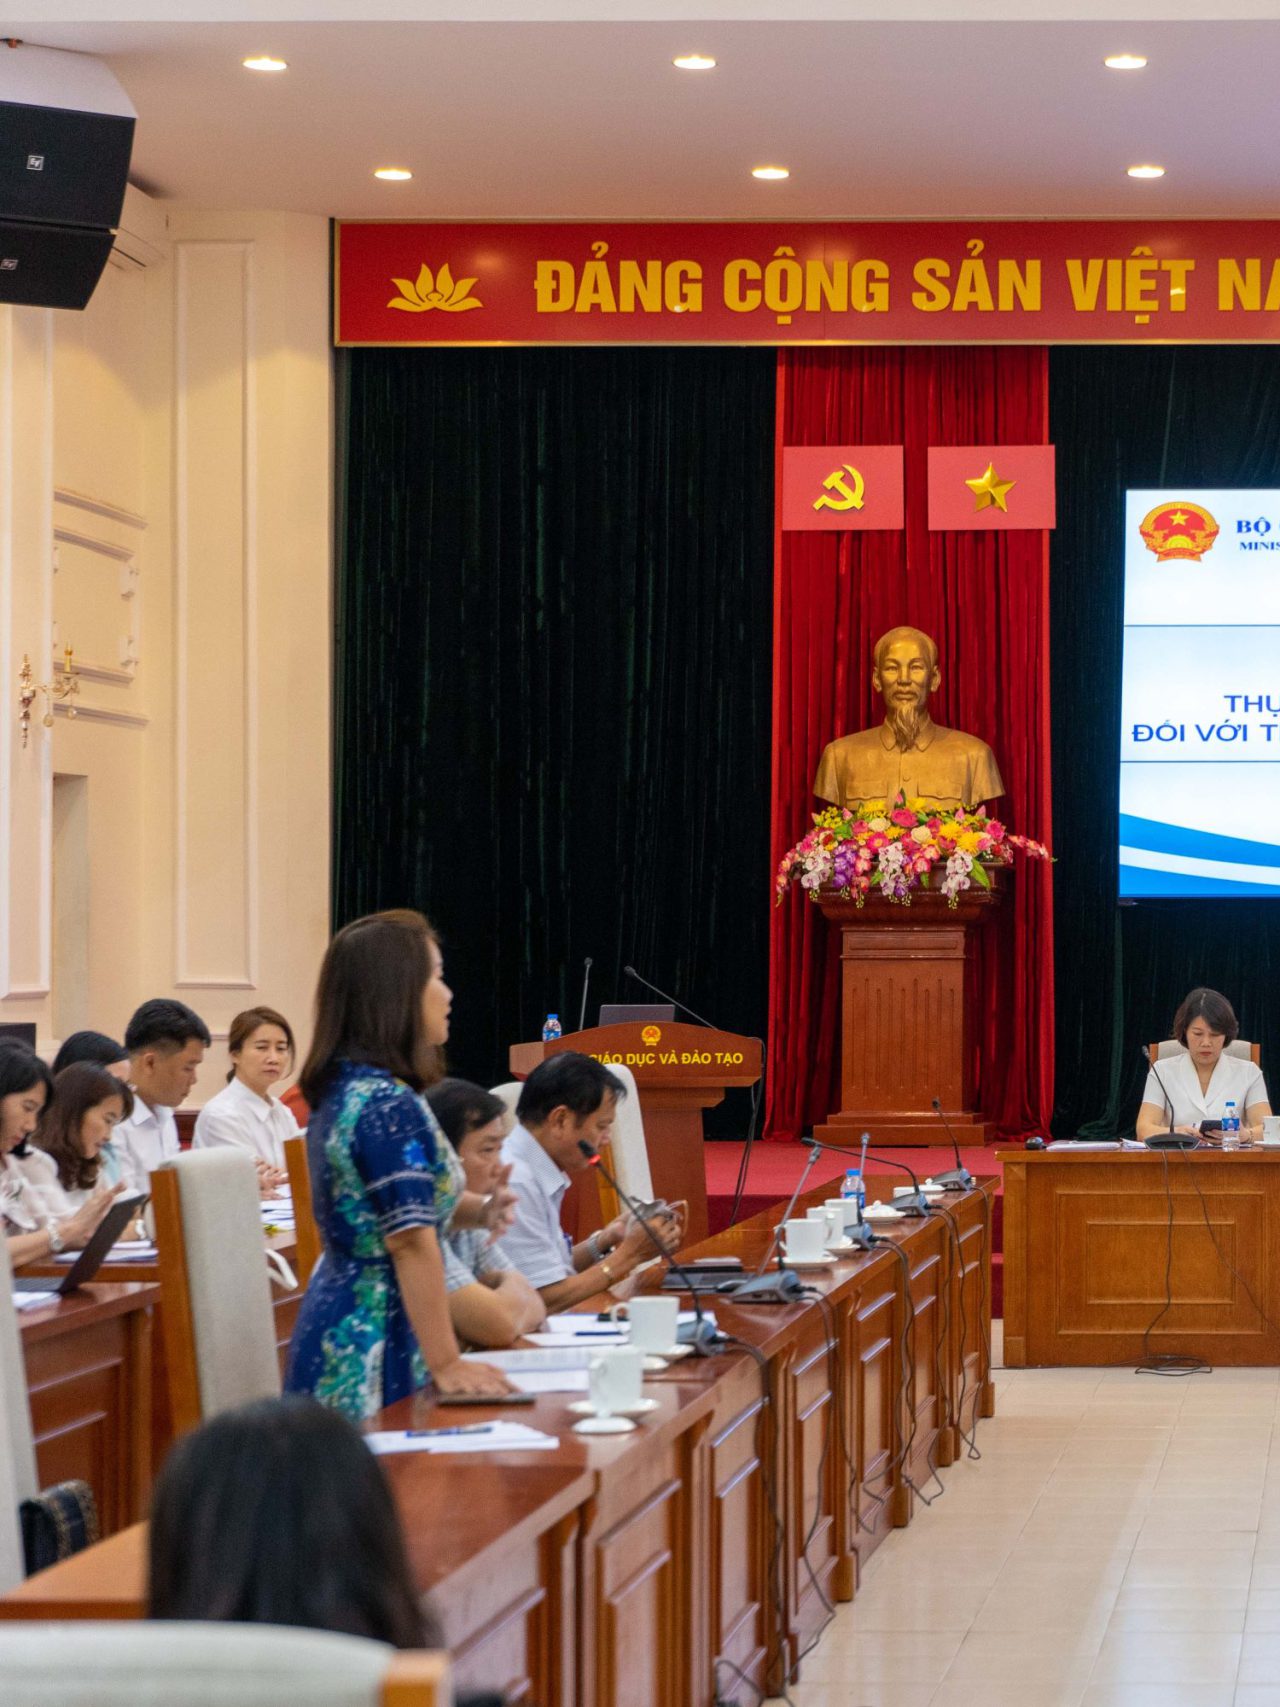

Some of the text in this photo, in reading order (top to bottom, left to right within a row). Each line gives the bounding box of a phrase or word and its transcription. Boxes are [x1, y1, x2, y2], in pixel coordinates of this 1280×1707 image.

[534, 242, 702, 313] ĐẢNG
[723, 246, 890, 325] CỘNG
[911, 239, 1041, 312] SẢN
[1066, 246, 1195, 324] VIỆT
[1236, 516, 1271, 536] BỘ
[1132, 719, 1186, 743] ĐỐI
[1194, 719, 1249, 743] VỚI
[626, 1053, 656, 1068] DỤC
[659, 1050, 678, 1065] VÀ
[681, 1050, 712, 1065] ĐÀO
[715, 1052, 744, 1067] TẠO
